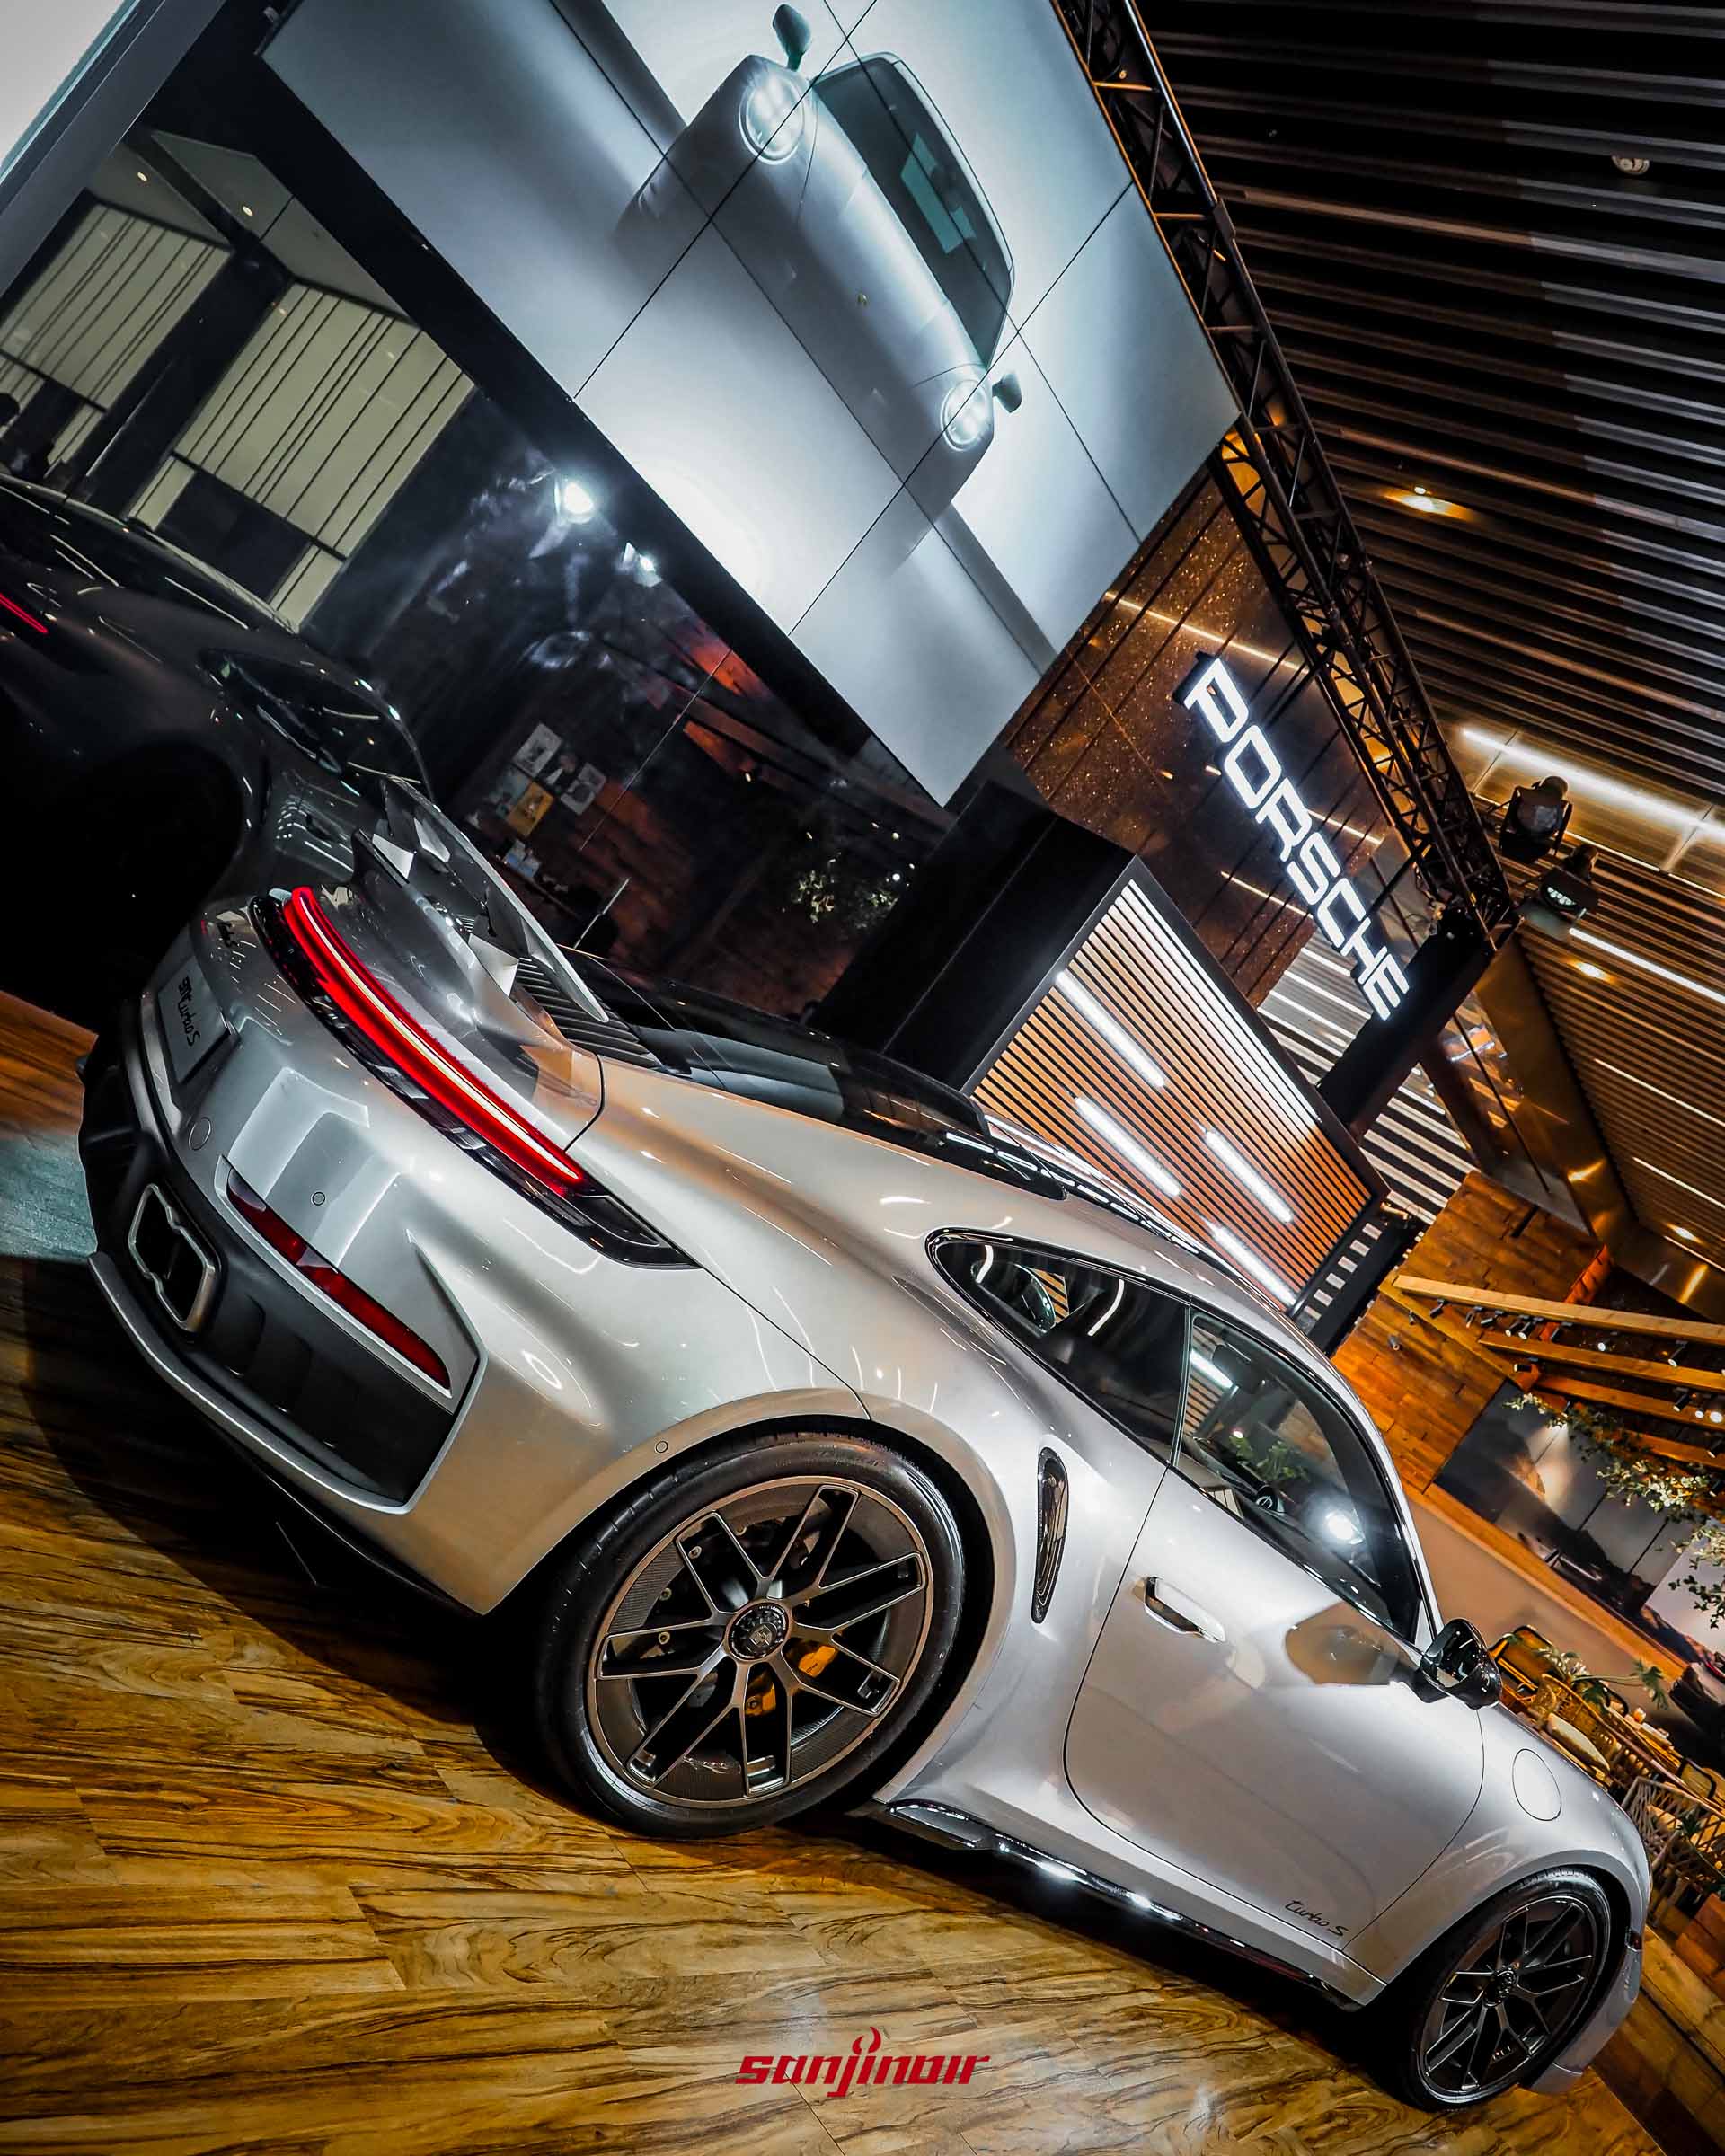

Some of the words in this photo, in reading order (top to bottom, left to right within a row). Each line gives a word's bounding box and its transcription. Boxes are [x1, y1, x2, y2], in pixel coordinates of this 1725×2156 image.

[1184, 658, 1410, 1021] PORSCHE
[186, 1030, 200, 1047] S
[1285, 1900, 1330, 1926] turbo
[1327, 1925, 1349, 1936] S
